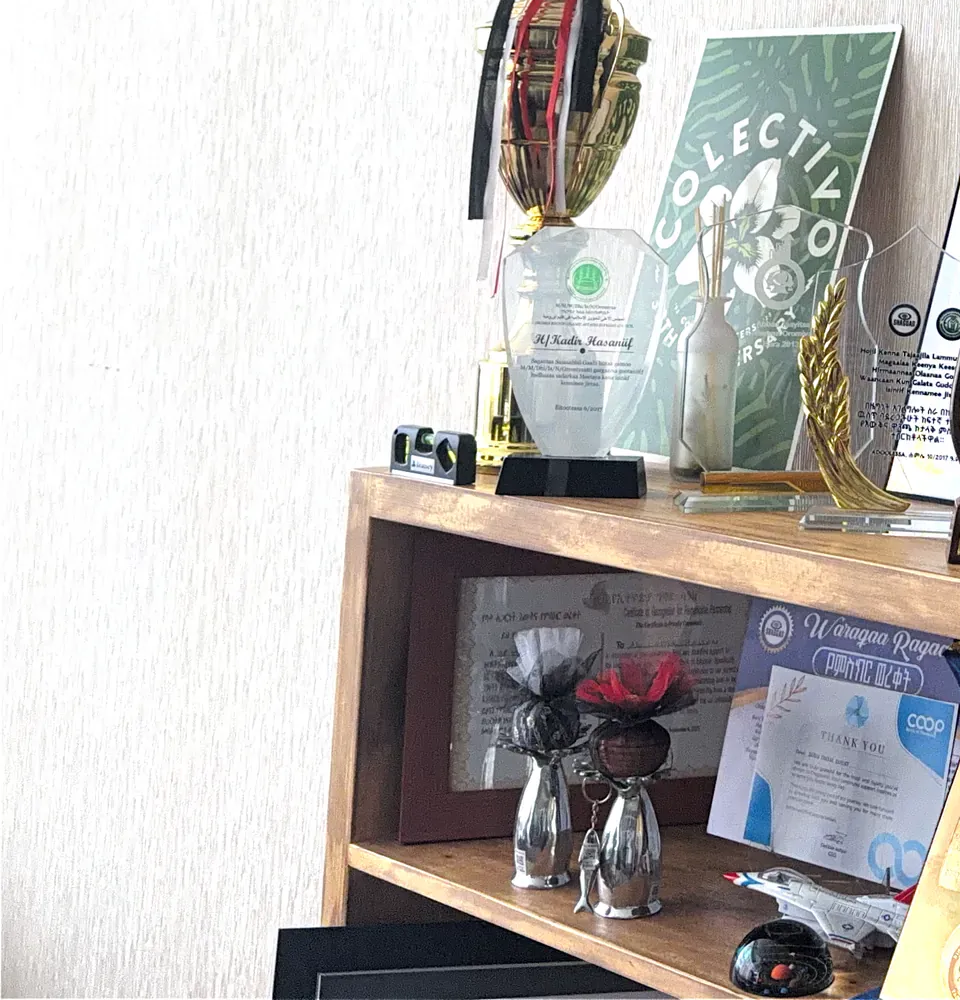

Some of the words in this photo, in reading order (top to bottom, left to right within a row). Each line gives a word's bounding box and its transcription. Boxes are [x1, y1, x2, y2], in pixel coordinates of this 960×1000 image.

[655, 112, 841, 257] COLECTIVO
[938, 363, 956, 371] Kees
[803, 612, 889, 648] Waragaa
[821, 730, 858, 748] THANK
[861, 740, 886, 754] YOU
